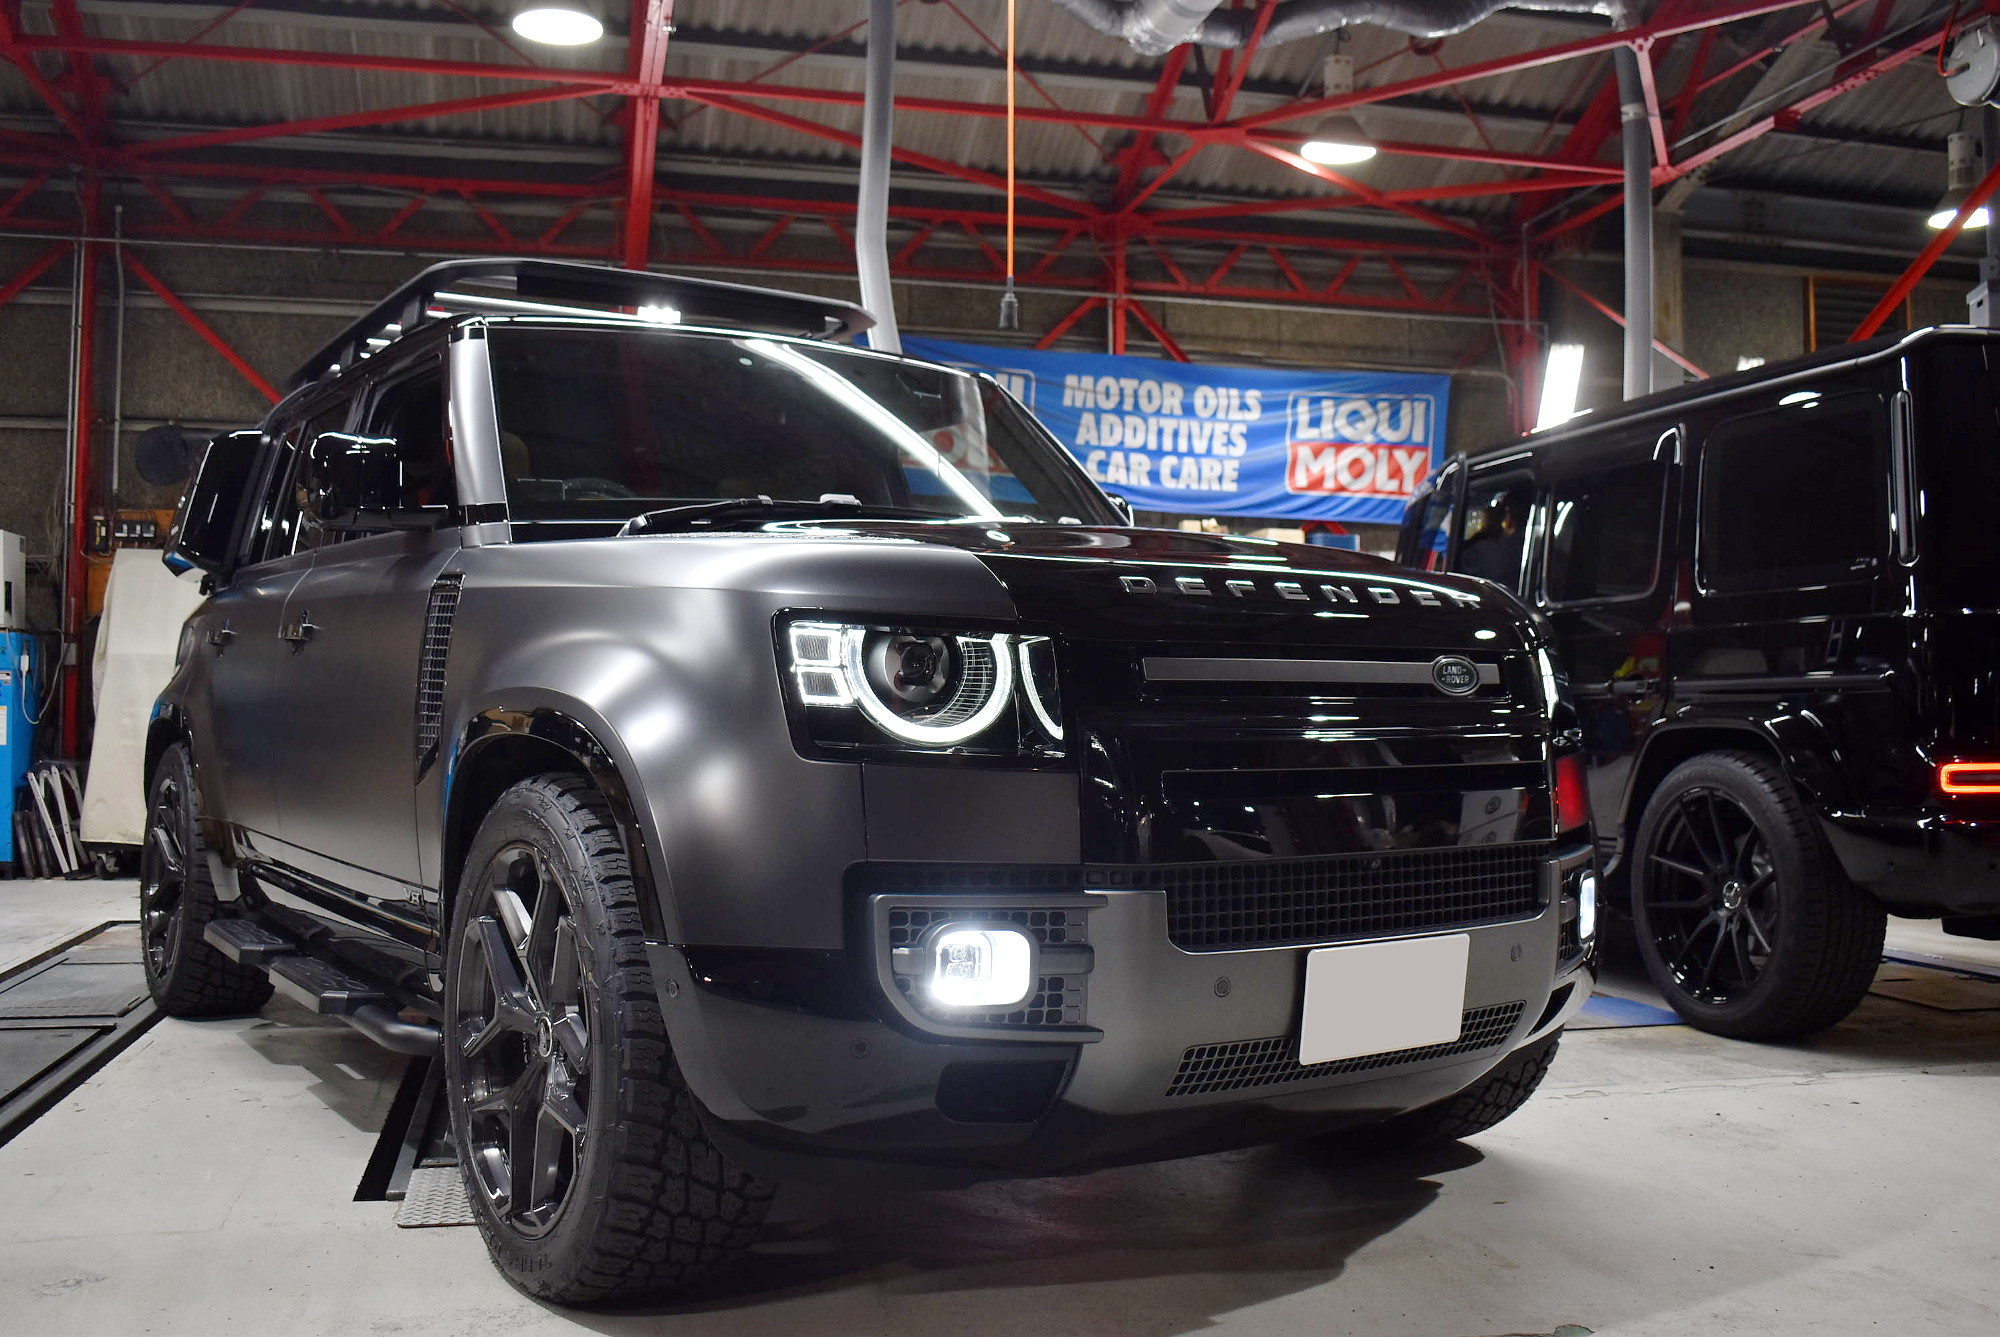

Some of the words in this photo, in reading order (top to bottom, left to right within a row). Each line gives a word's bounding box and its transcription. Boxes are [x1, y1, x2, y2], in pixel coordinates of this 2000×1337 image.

[1063, 374, 1185, 415] MOTOR
[1193, 385, 1263, 421] OILS
[1075, 412, 1248, 457] ADDITIVES
[1296, 398, 1427, 444] LIQUI
[1086, 450, 1151, 486] CAR
[1159, 455, 1241, 492] CARE
[1295, 446, 1427, 493] MOLY
[1119, 575, 1482, 609] DEFENDER
